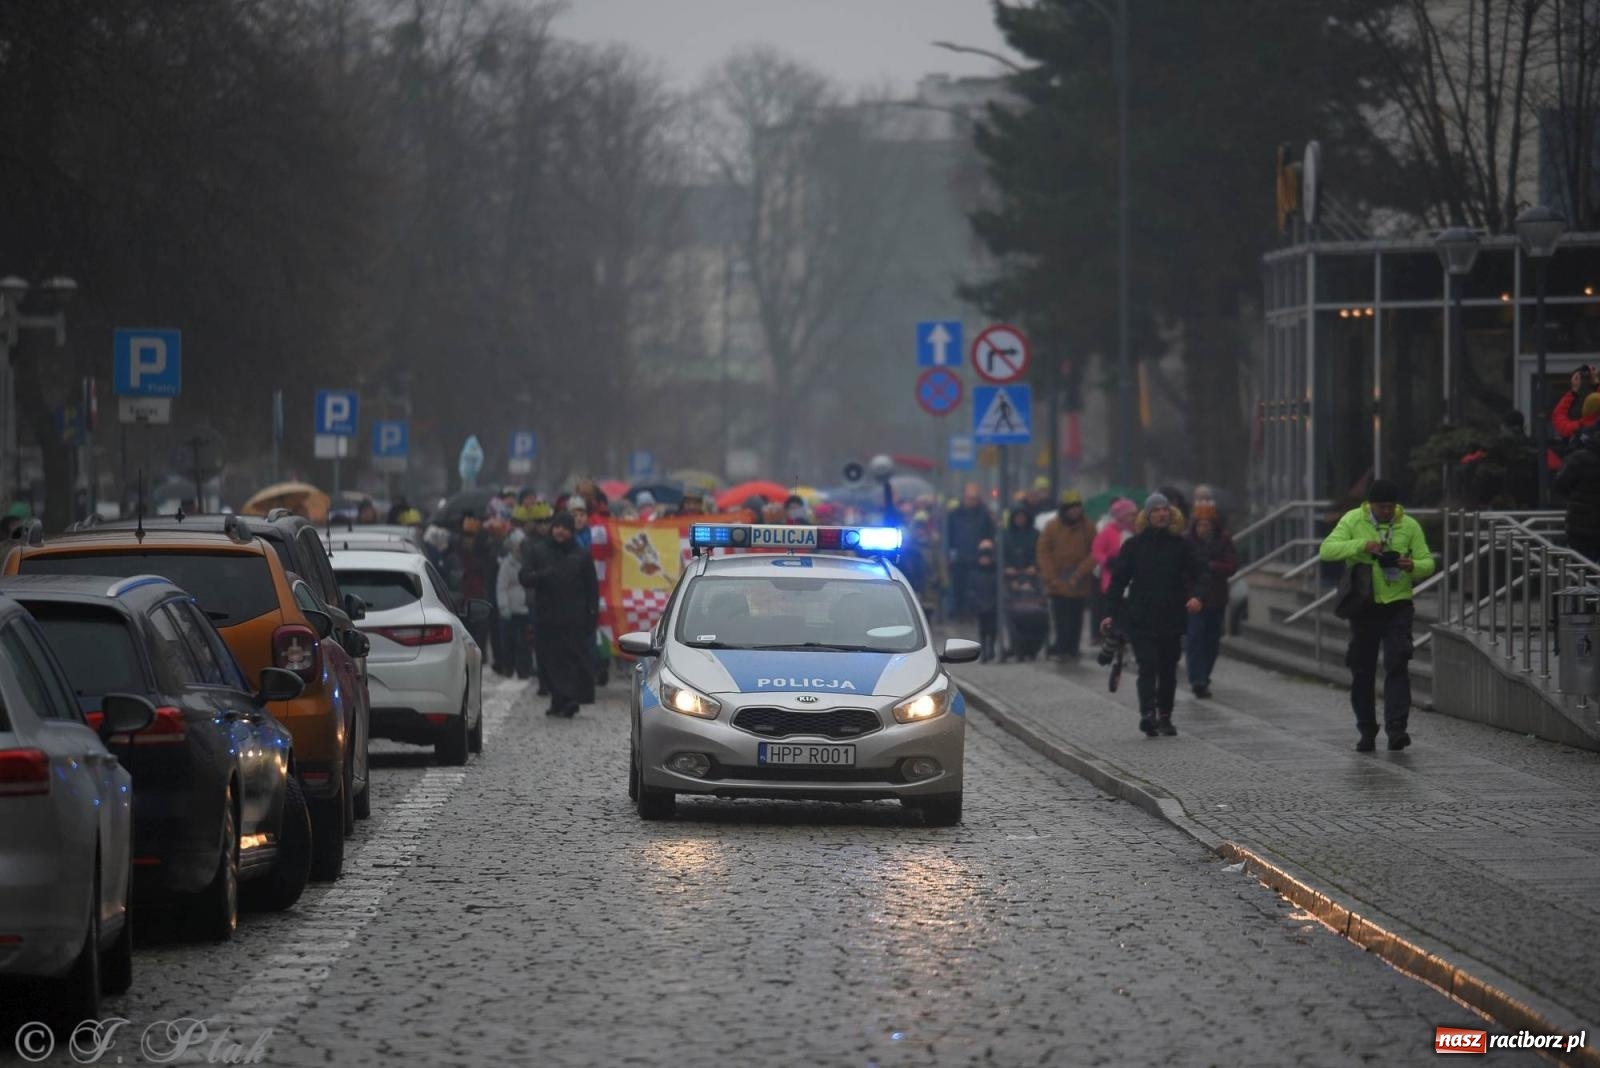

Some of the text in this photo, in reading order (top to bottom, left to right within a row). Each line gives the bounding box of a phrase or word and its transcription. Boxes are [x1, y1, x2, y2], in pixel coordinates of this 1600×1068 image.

[129, 337, 167, 387] P
[325, 395, 350, 430] P
[381, 424, 401, 451] P
[753, 528, 816, 546] POLICJA
[757, 678, 856, 690] POLICJA
[770, 746, 849, 764] HPP R001
